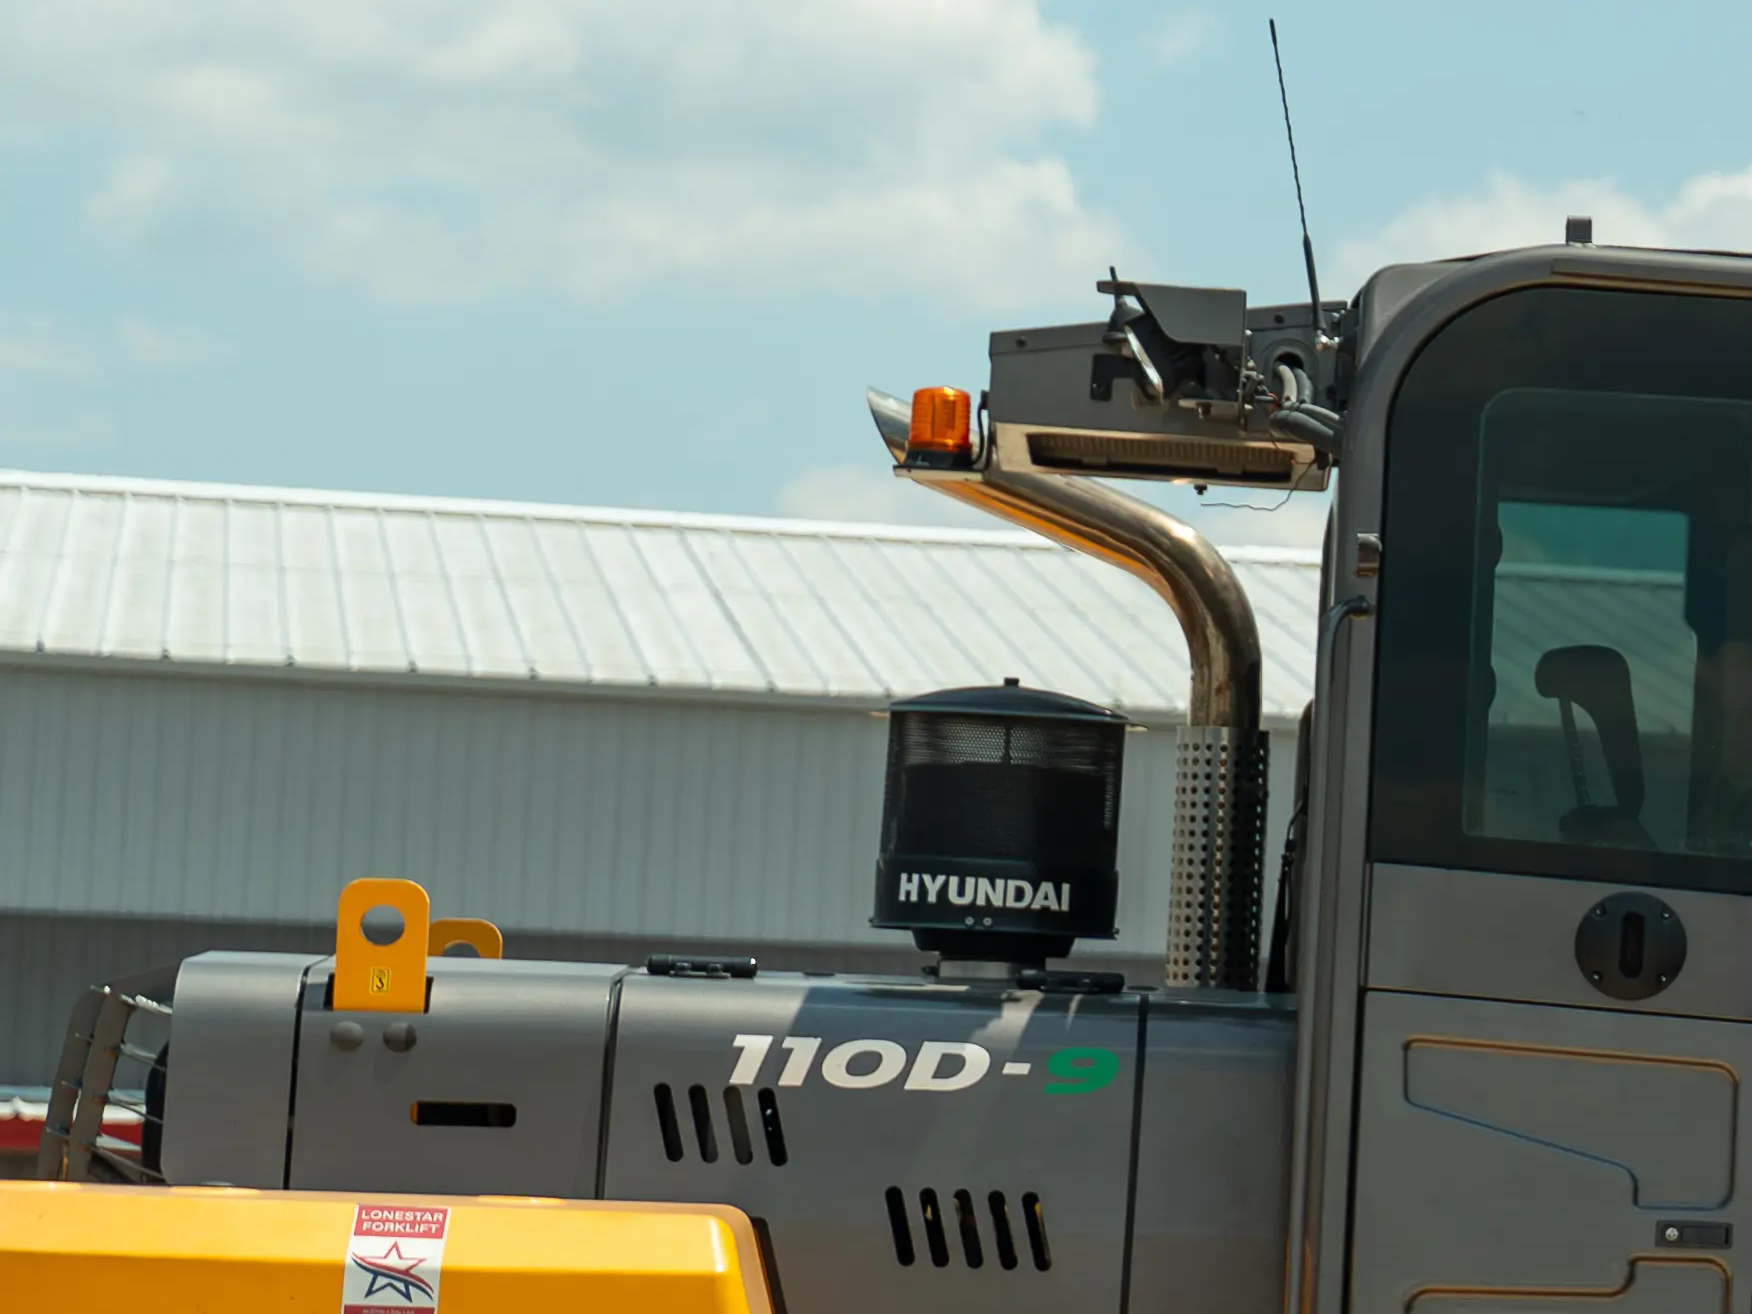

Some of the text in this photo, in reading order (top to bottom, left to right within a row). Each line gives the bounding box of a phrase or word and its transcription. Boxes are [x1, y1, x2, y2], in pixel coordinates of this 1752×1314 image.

[898, 872, 1070, 913] HYUNDAI
[728, 1034, 1120, 1096] 110D-9
[361, 1210, 444, 1222] LONESTAR
[362, 1221, 440, 1233] FORKLIFT
